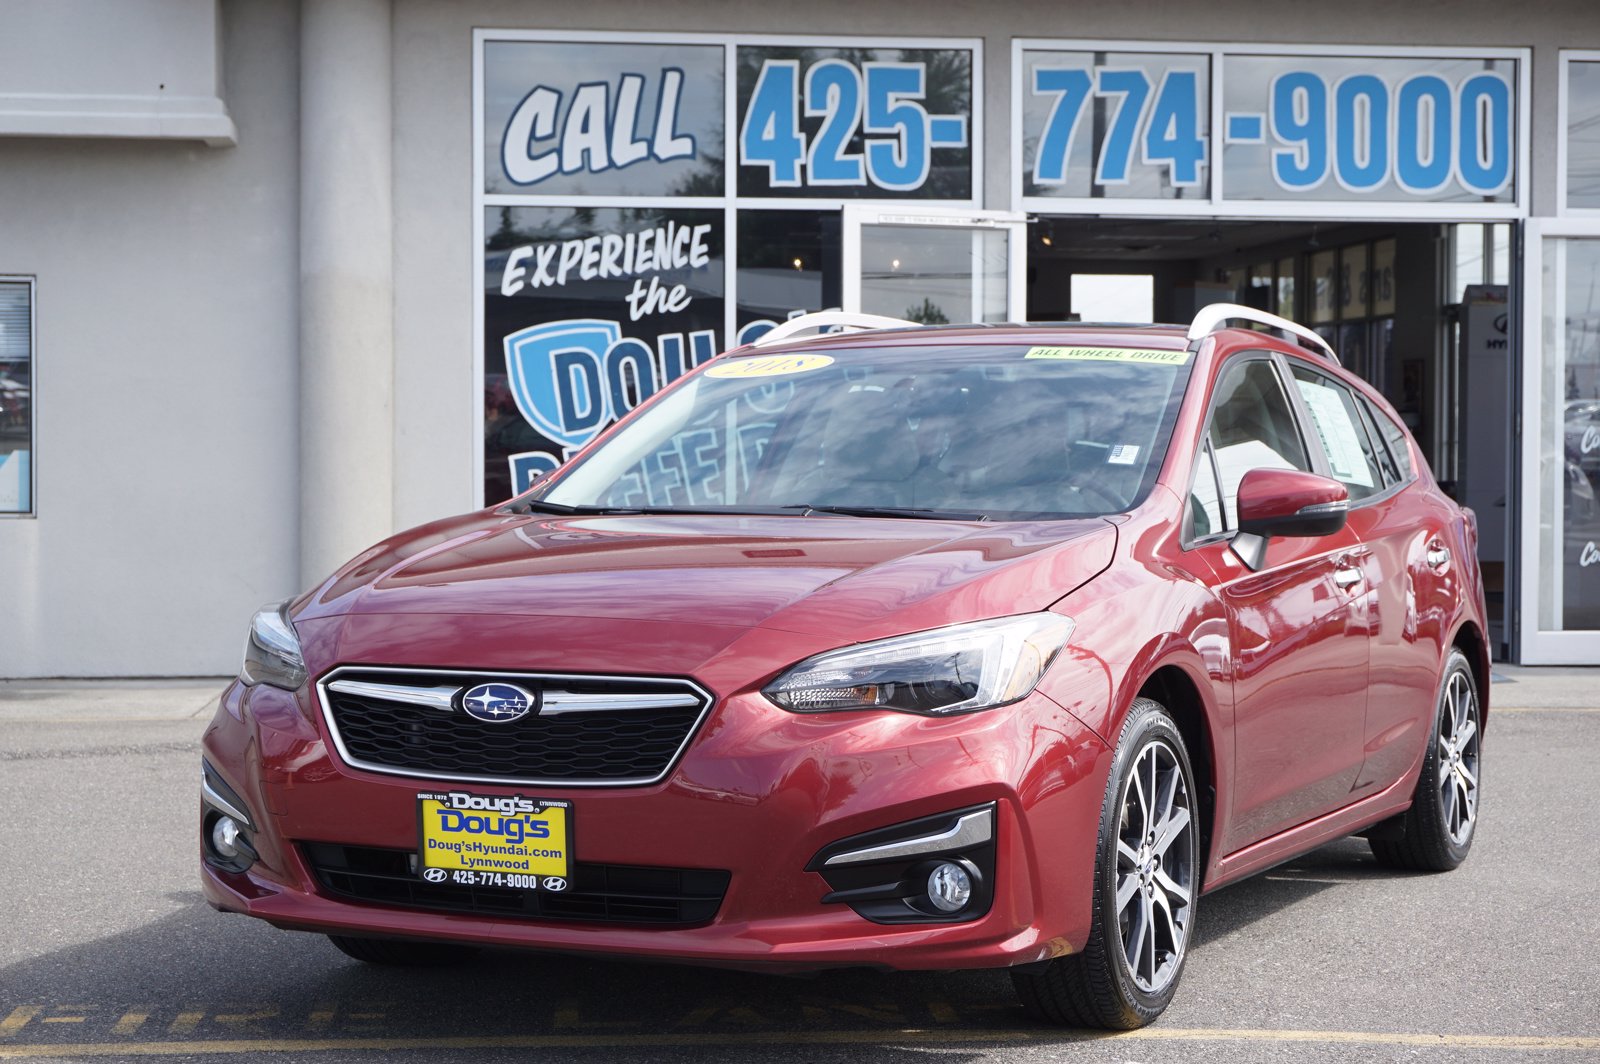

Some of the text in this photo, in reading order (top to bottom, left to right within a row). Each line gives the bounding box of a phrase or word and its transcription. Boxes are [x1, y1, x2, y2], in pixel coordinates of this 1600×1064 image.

[502, 66, 696, 185] CALL
[501, 220, 711, 297] EXPERIENCE
[625, 276, 692, 321] the
[1034, 348, 1183, 362] ALL WHEEL DRIVE
[449, 793, 534, 816] Doug's
[540, 800, 568, 808] LYNNWOOD
[437, 809, 550, 844] Doug's
[461, 855, 529, 870] Lynnwood
[453, 870, 537, 889] 425-774-9000
